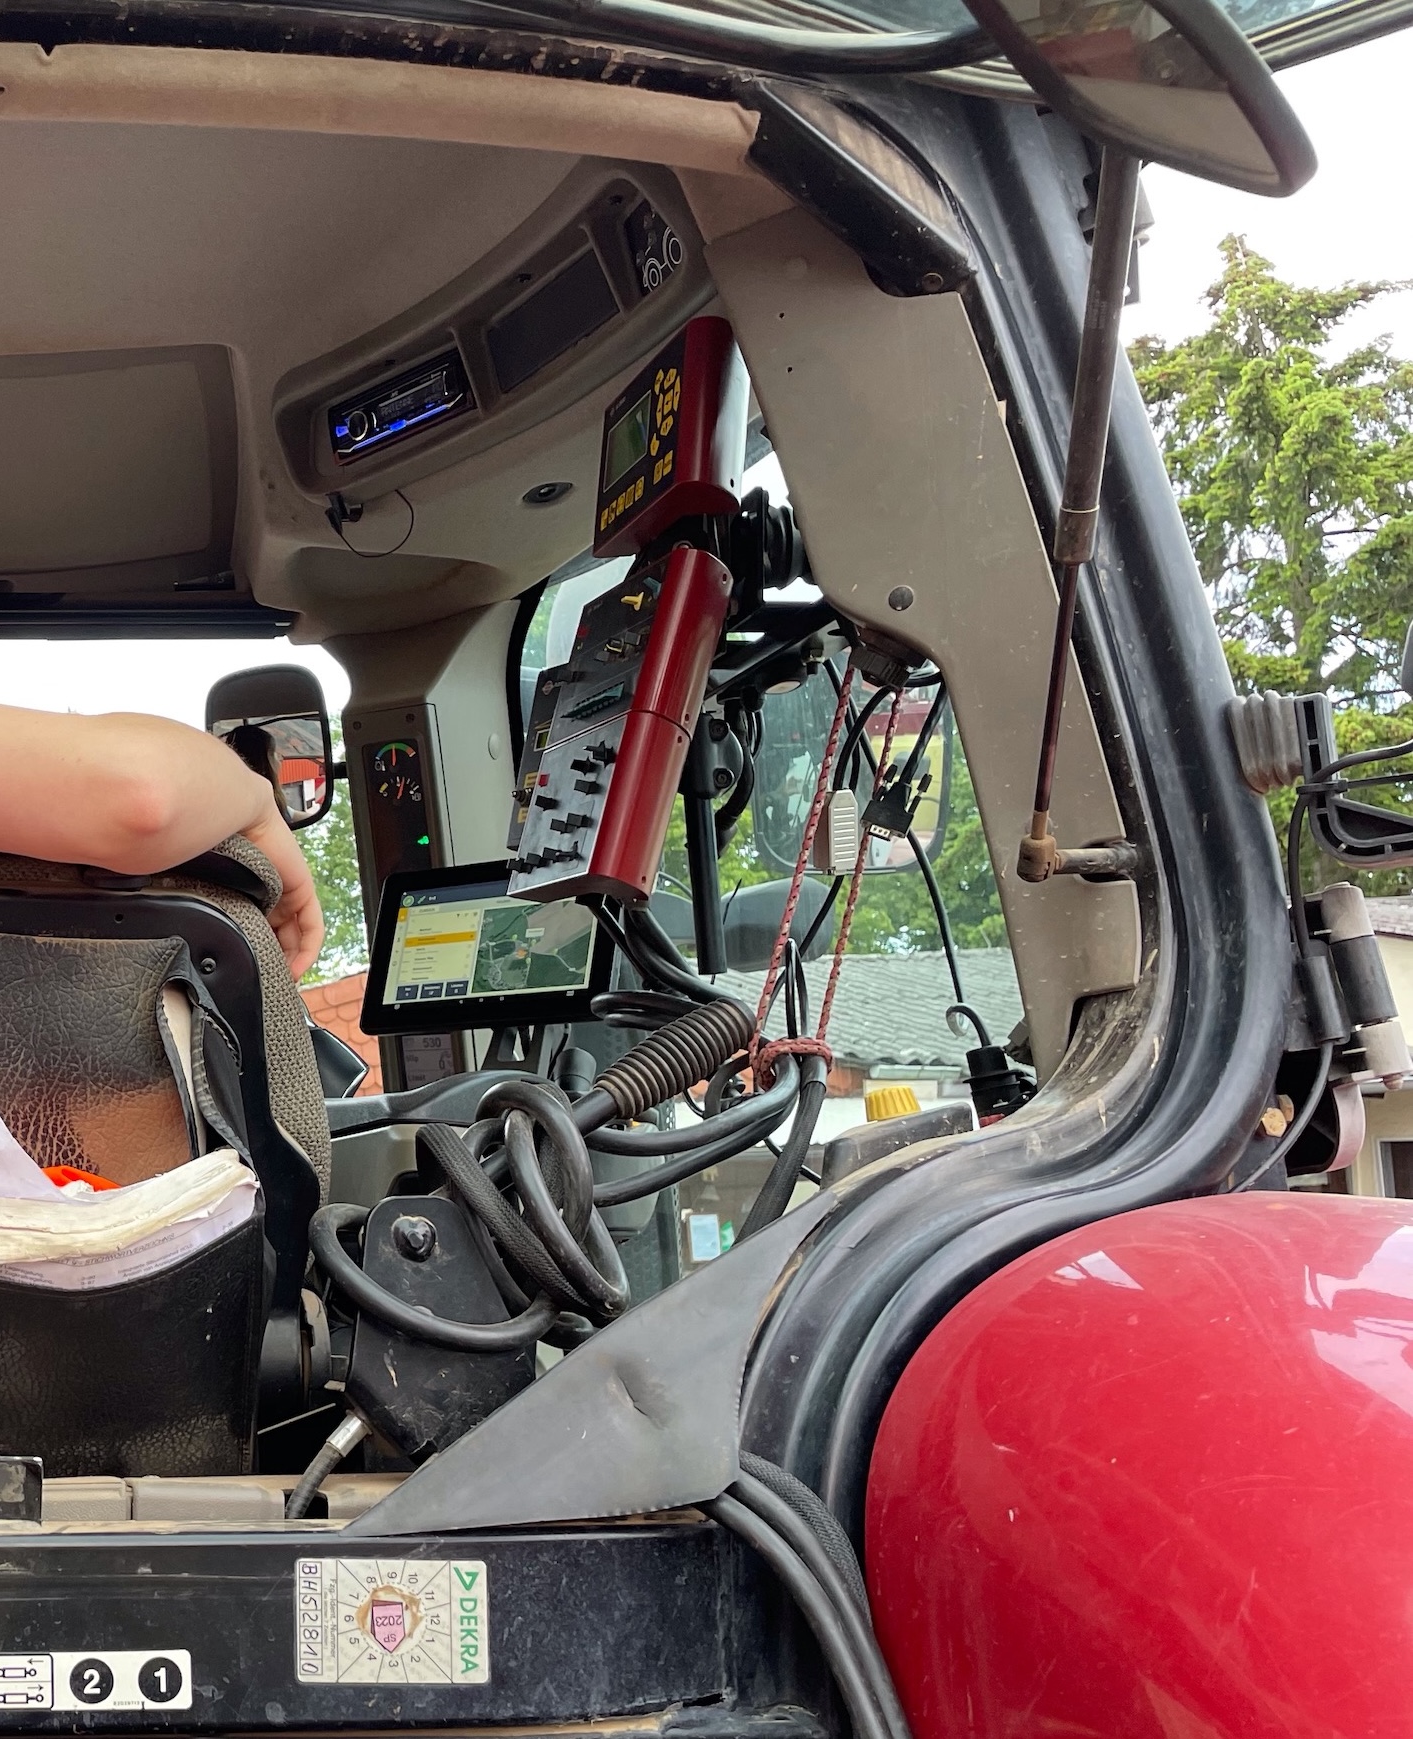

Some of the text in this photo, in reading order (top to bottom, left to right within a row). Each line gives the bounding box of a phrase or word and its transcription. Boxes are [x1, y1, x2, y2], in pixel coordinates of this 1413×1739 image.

[422, 1037, 442, 1048] 530
[366, 1576, 377, 1584] 8
[387, 1571, 397, 1579] 9
[408, 1573, 418, 1584] 10
[424, 1589, 435, 1600] 11
[343, 1614, 355, 1623] 6
[375, 1614, 403, 1628] 2023
[430, 1613, 440, 1625] 12
[383, 1633, 397, 1643] SP
[459, 1597, 479, 1674] DEKRA
[349, 1637, 360, 1645] 5
[367, 1653, 377, 1661] 4
[410, 1655, 421, 1663] 2
[388, 1660, 399, 1668] 3
[82, 1666, 168, 1695] 2 1
